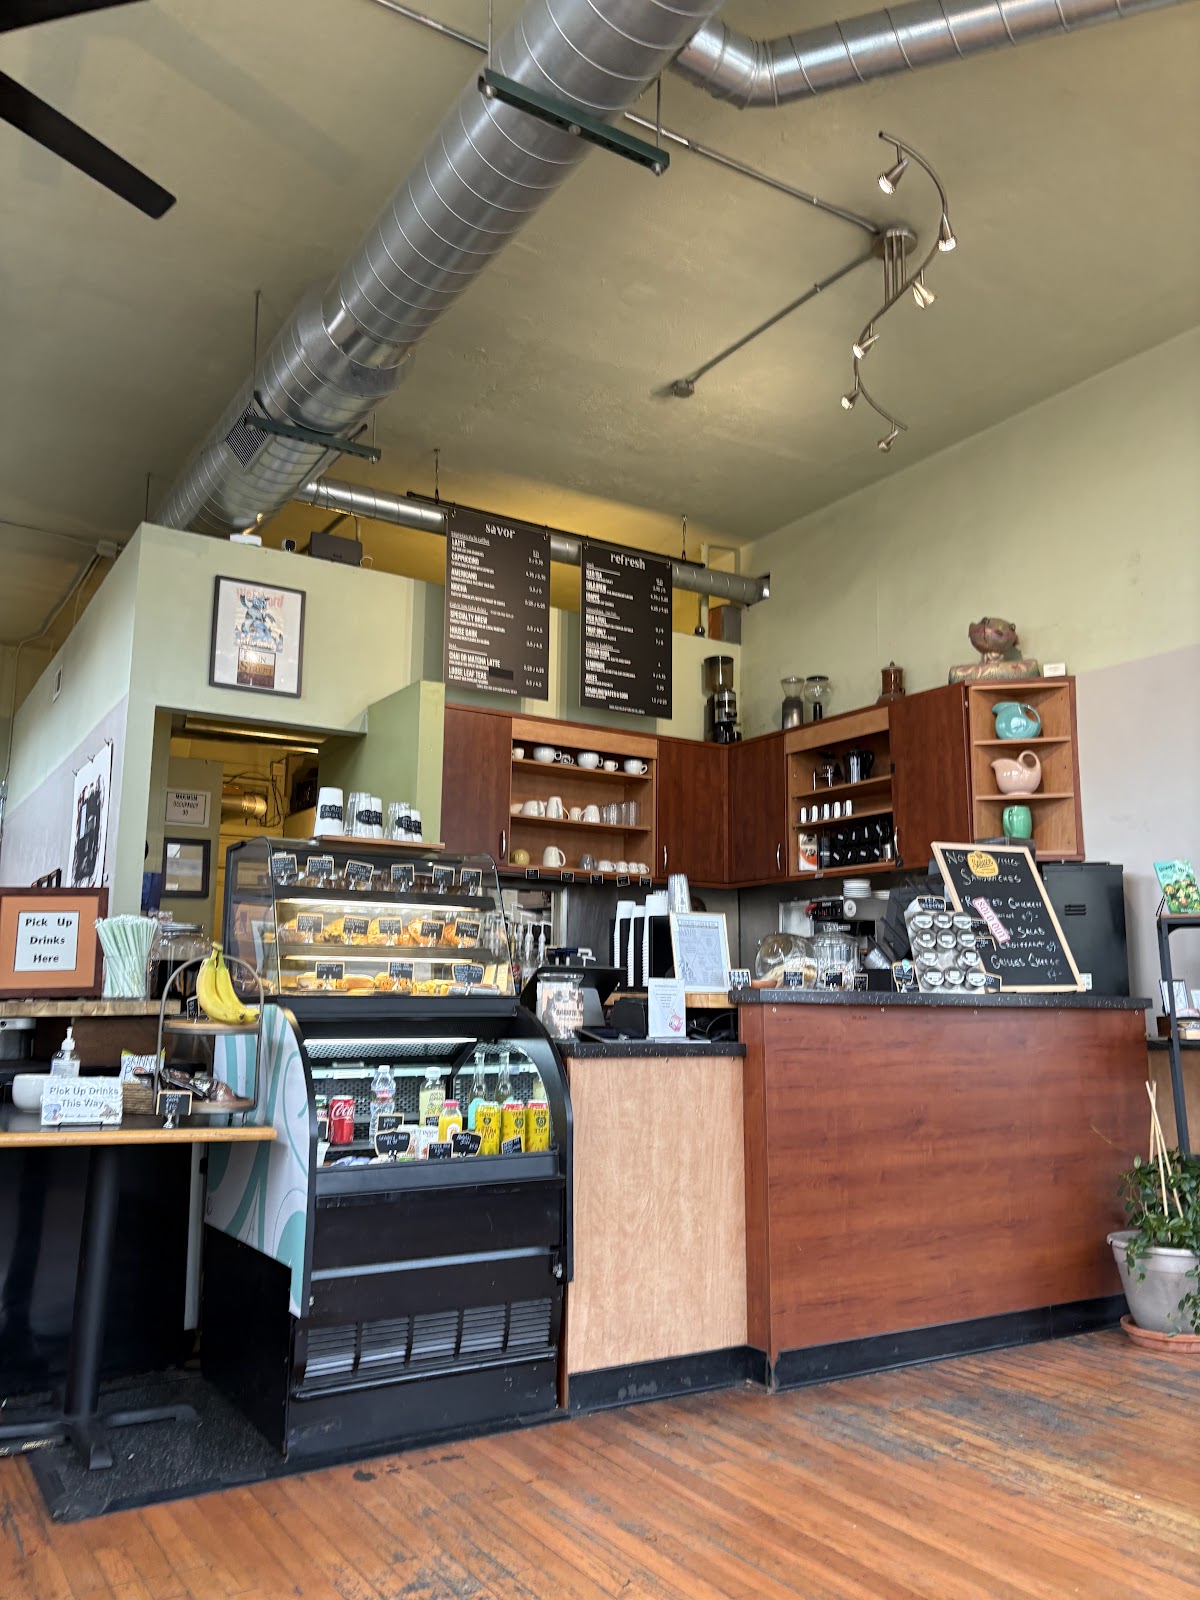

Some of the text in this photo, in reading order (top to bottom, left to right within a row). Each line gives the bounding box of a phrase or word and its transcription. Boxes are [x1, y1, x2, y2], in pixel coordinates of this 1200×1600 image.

[485, 523, 516, 539] savor
[451, 552, 480, 566] CAPPUCCINO
[610, 553, 646, 571] refresh
[451, 568, 478, 581] AMERICANO
[487, 657, 501, 669] LATTE
[25, 917, 74, 929] Pick Up
[991, 920, 1007, 939] OUT
[30, 935, 66, 946] Drinks
[33, 954, 60, 964] Here
[50, 1086, 119, 1098] Pick Up Drinks
[61, 1098, 105, 1111] This Way
